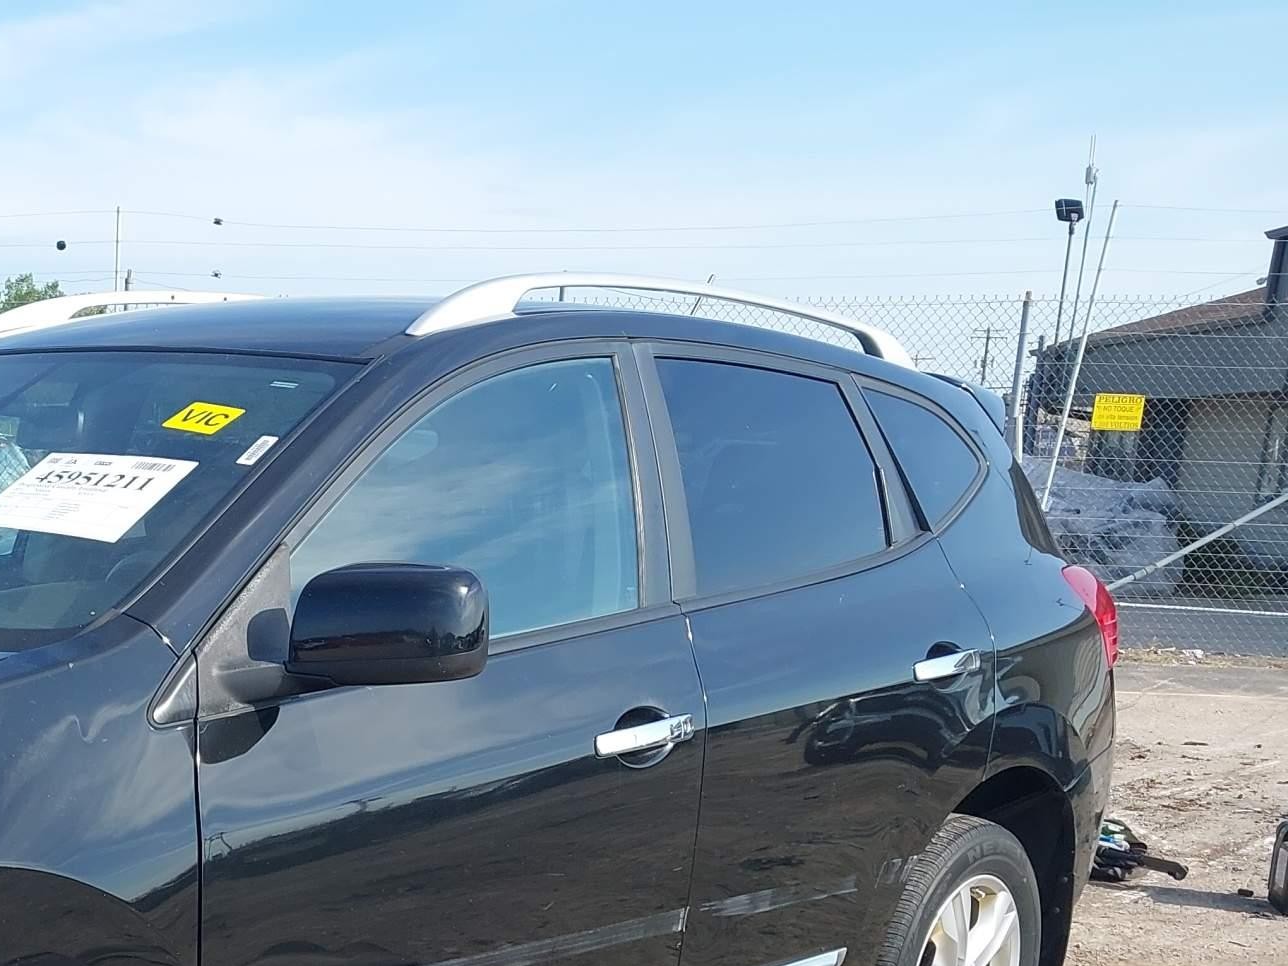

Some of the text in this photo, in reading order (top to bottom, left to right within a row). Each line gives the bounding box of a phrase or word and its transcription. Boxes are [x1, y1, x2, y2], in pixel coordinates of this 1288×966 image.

[1098, 395, 1142, 404] PELIGRO
[181, 408, 230, 427] VIC
[35, 469, 155, 491] 45951211
